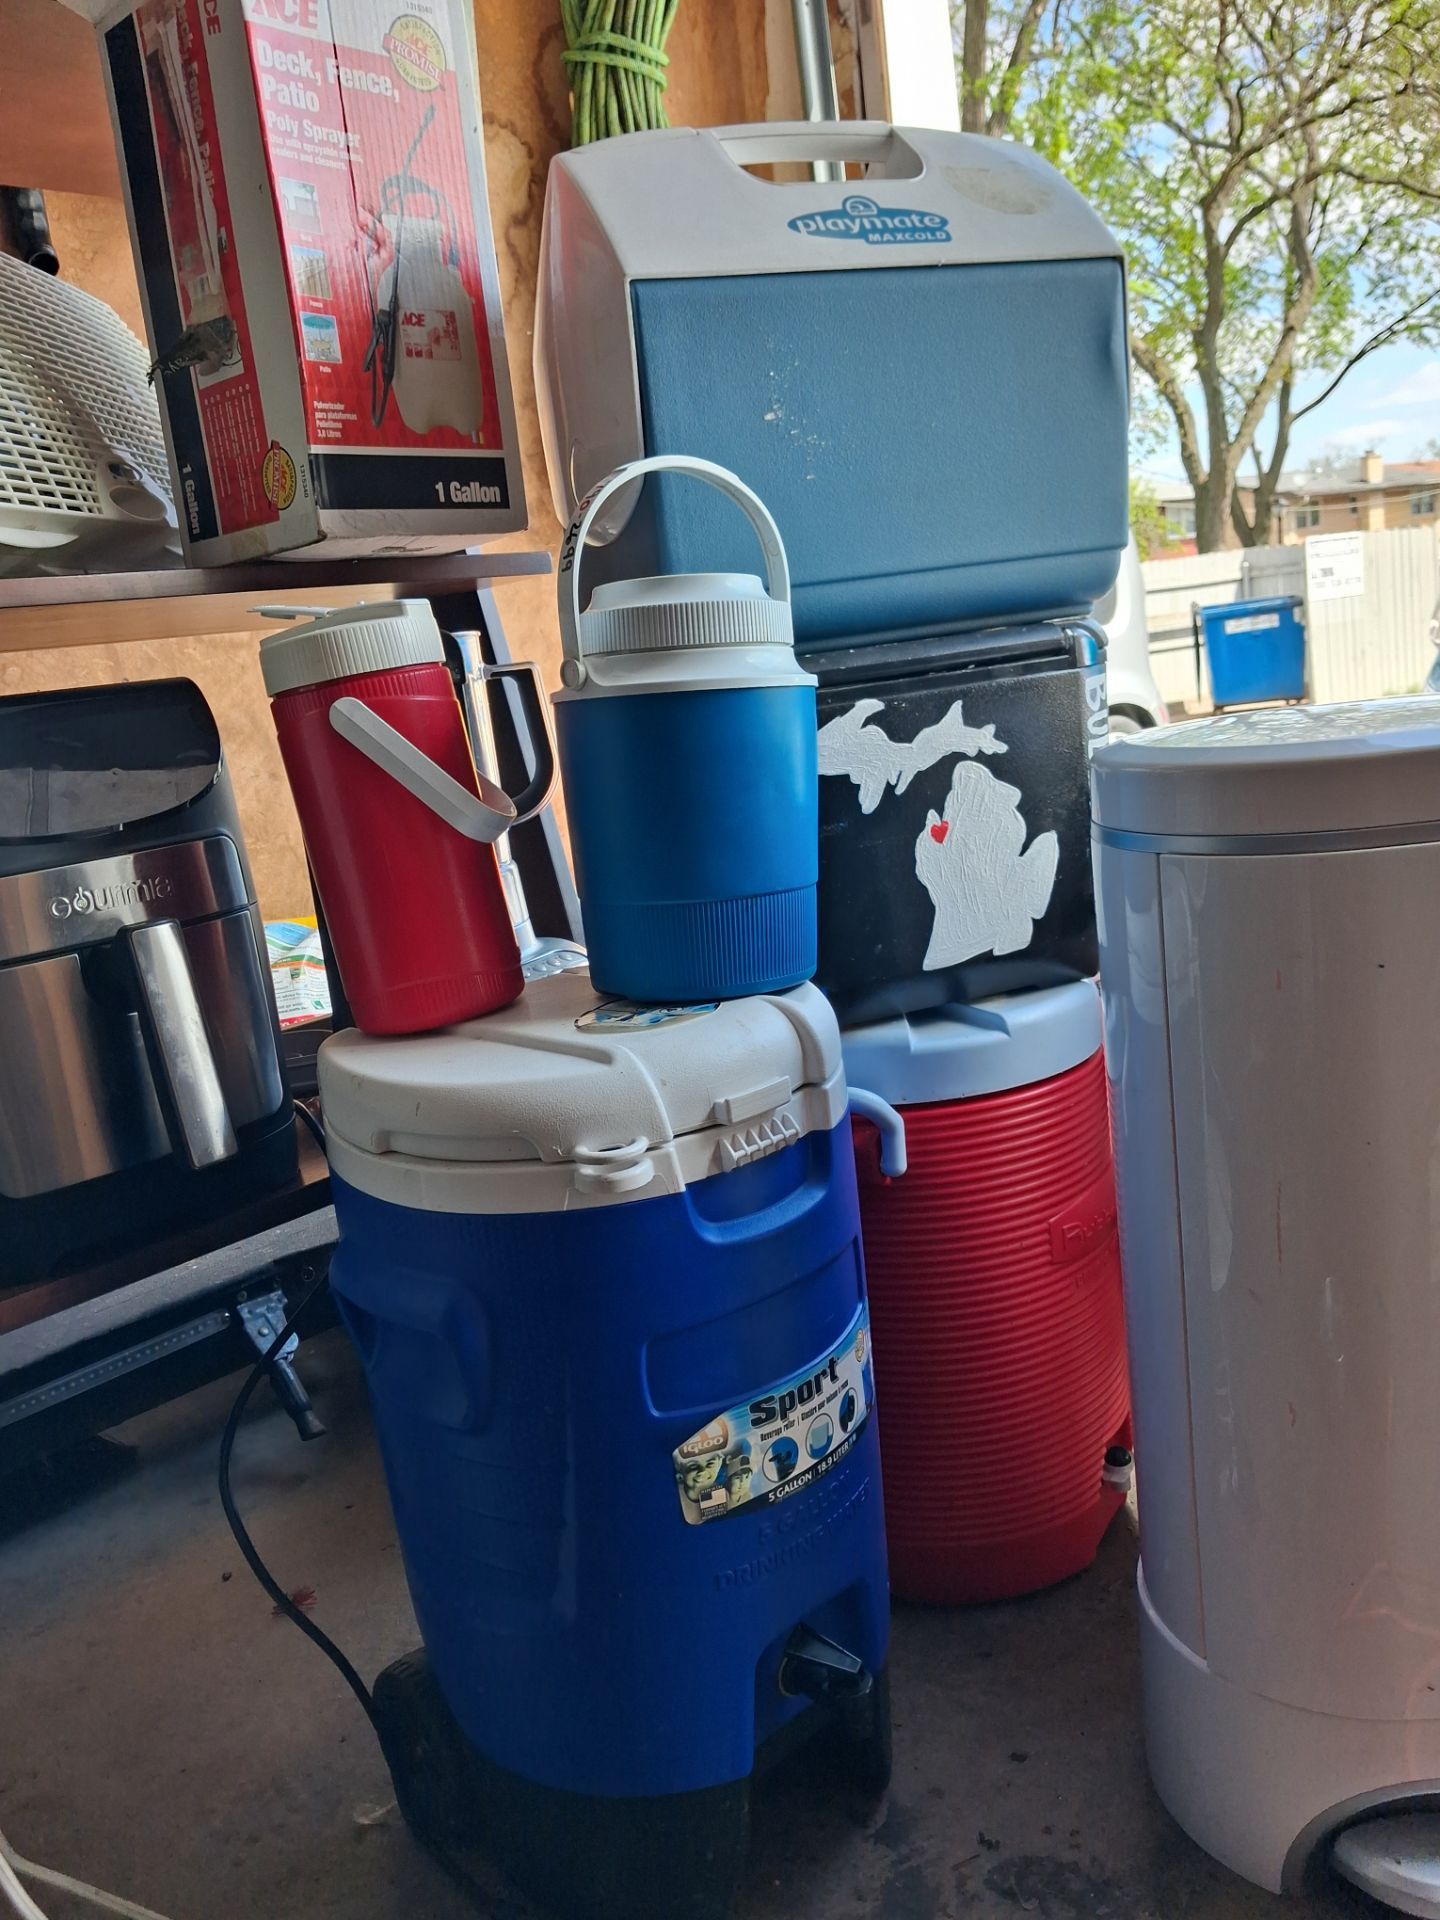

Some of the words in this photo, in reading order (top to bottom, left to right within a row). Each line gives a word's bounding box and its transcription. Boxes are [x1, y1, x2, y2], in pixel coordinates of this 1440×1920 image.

[203, 0, 222, 36] CE
[256, 38, 321, 86] Deck,
[325, 57, 400, 104] Fence,
[261, 72, 320, 113] Patio
[267, 110, 299, 138] Poly
[303, 119, 361, 149] Sprayer
[796, 214, 942, 235] playmate
[868, 231, 947, 242] MAXCOLD
[401, 311, 426, 328] ACE
[185, 479, 200, 535] Gallon
[435, 481, 445, 503] 1
[449, 481, 501, 503] Gallon
[748, 1356, 841, 1430] Sport
[683, 1436, 724, 1454] IGLOO
[768, 1492, 775, 1503] 5
[776, 1471, 813, 1499] GALLON
[817, 1456, 833, 1474] 18.9
